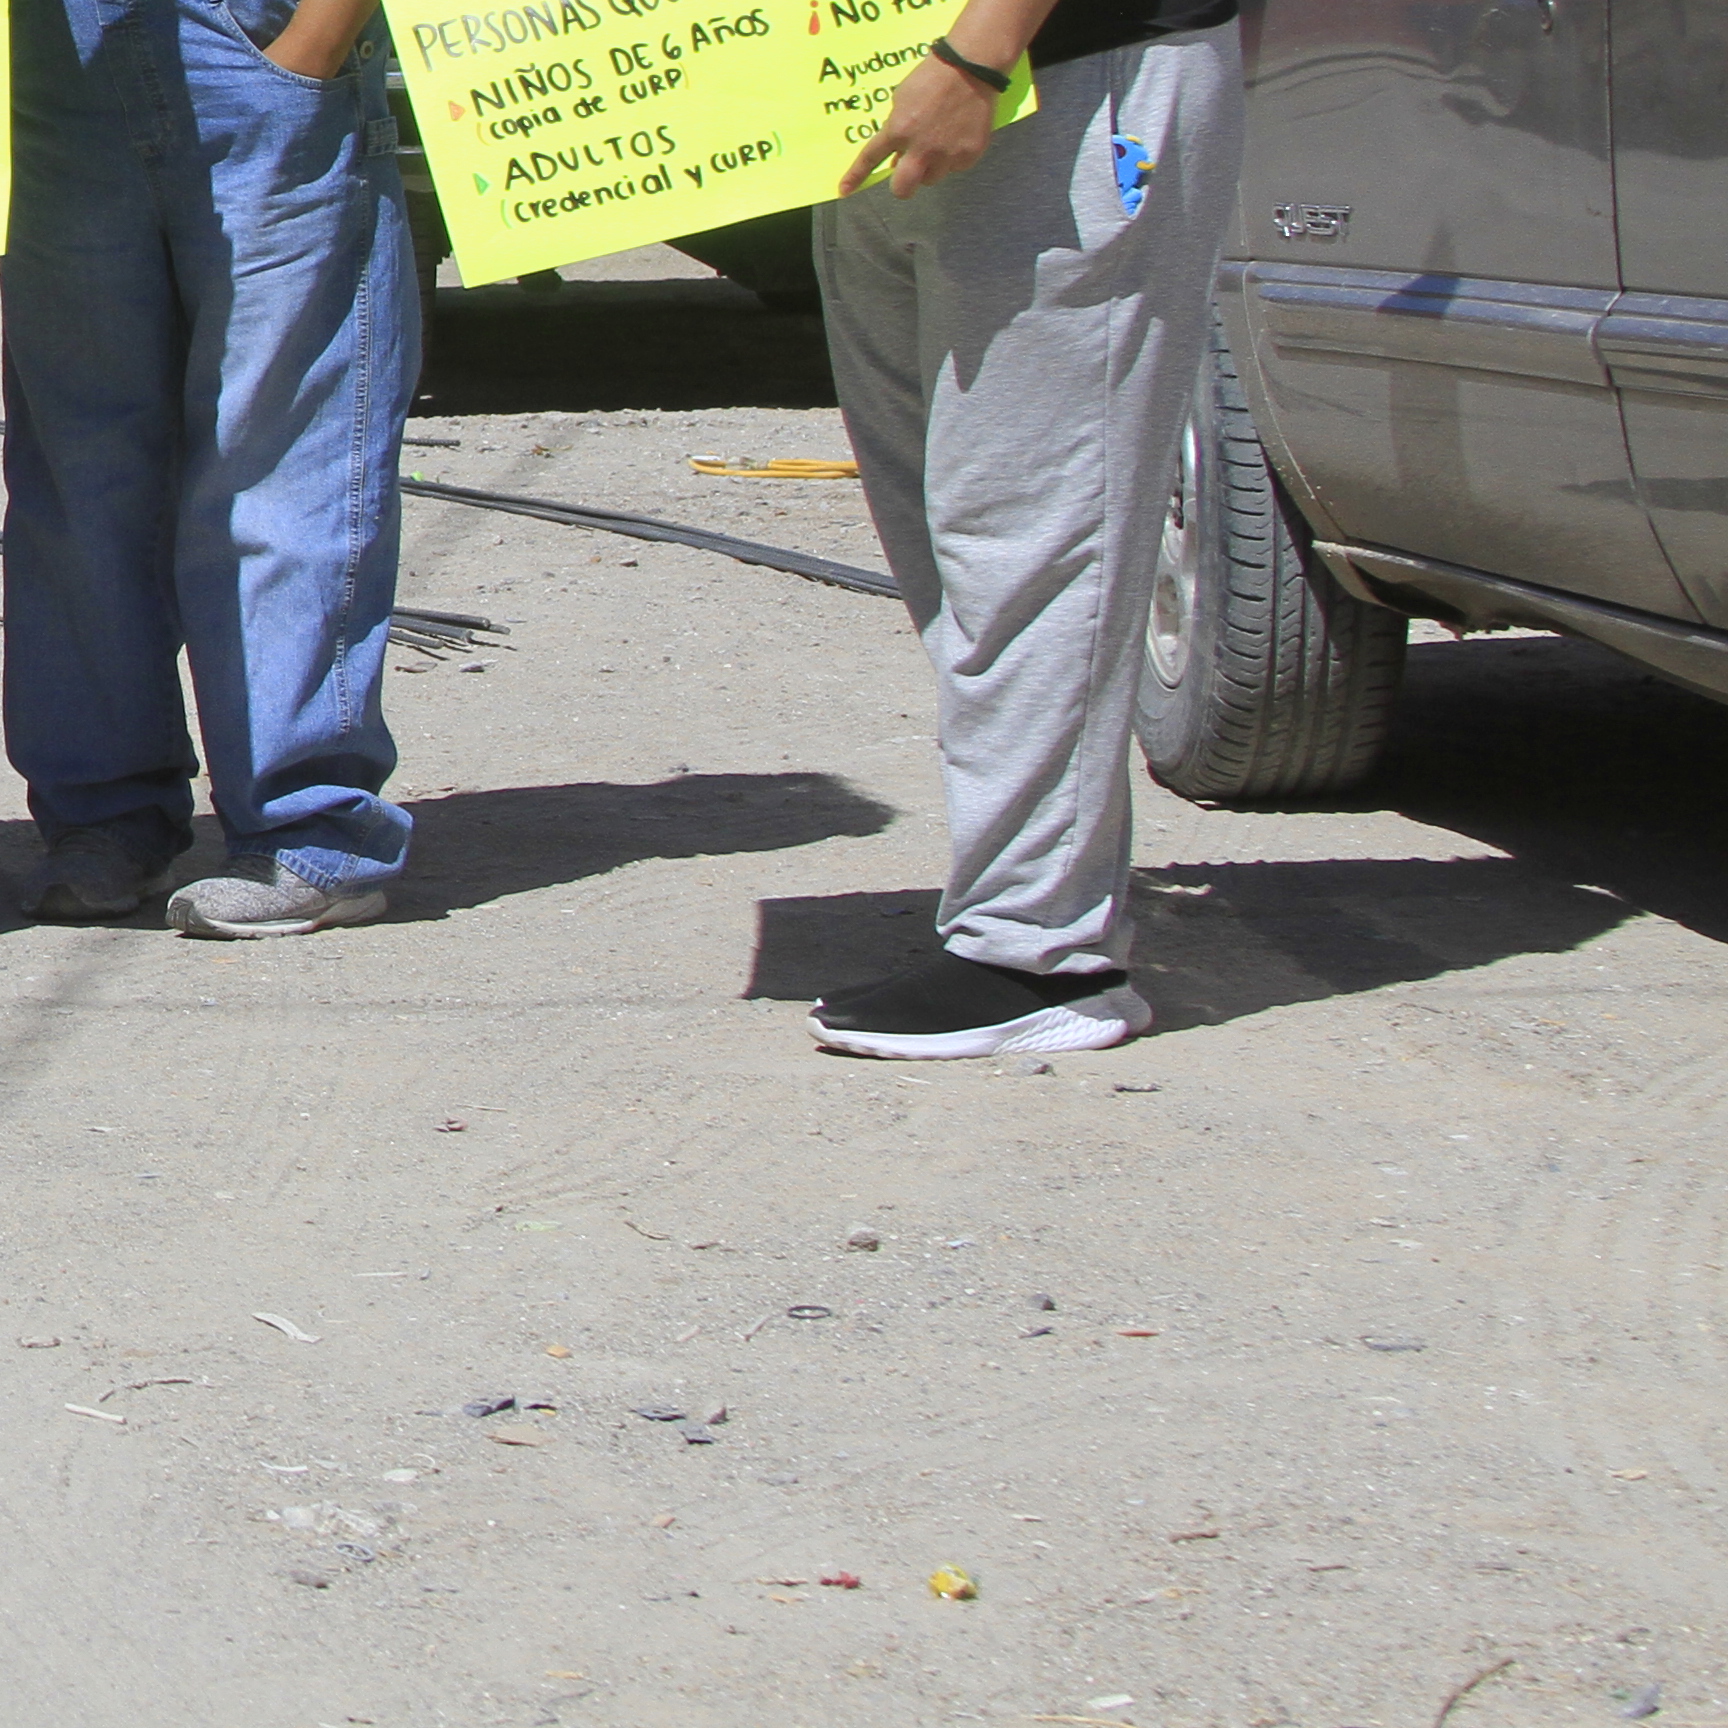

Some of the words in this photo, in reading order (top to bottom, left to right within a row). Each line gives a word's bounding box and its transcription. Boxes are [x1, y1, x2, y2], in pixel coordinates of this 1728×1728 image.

[468, 57, 593, 118] NIÑOS
[607, 41, 655, 77] DE
[660, 31, 684, 61] 6
[571, 94, 610, 120] de
[503, 123, 677, 192] ADULTOS
[1273, 201, 1352, 238] QUEST
